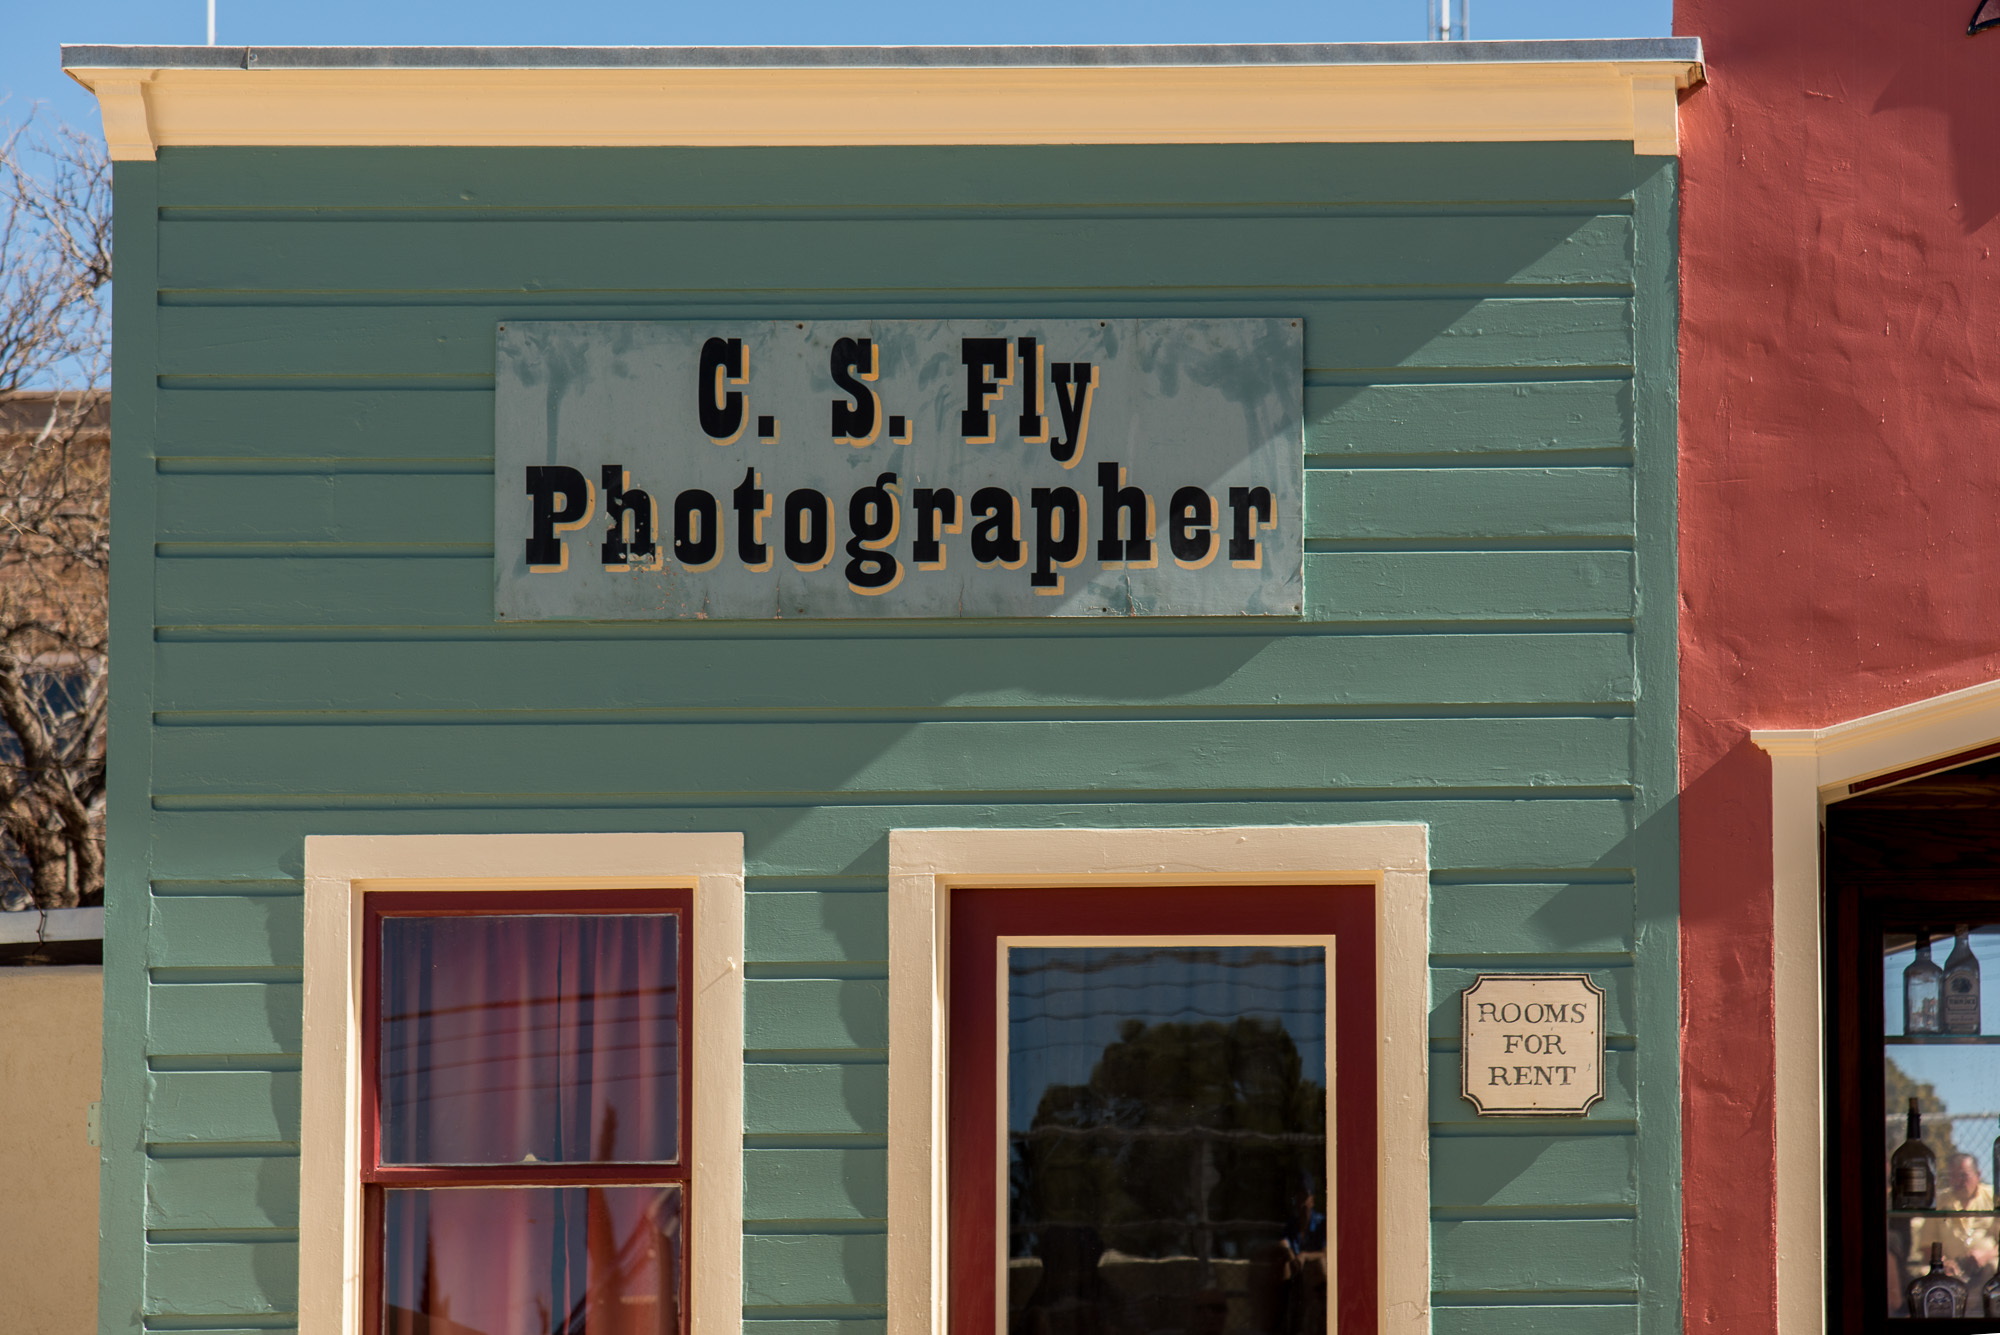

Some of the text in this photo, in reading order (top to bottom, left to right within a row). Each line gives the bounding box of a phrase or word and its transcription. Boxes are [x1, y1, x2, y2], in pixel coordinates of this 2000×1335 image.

[698, 337, 1099, 469] C. S. Fly
[525, 462, 1277, 596] Photographer
[1477, 1003, 1587, 1023] ROOMS
[1502, 1034, 1567, 1055] FOR
[1488, 1066, 1577, 1086] RENT
